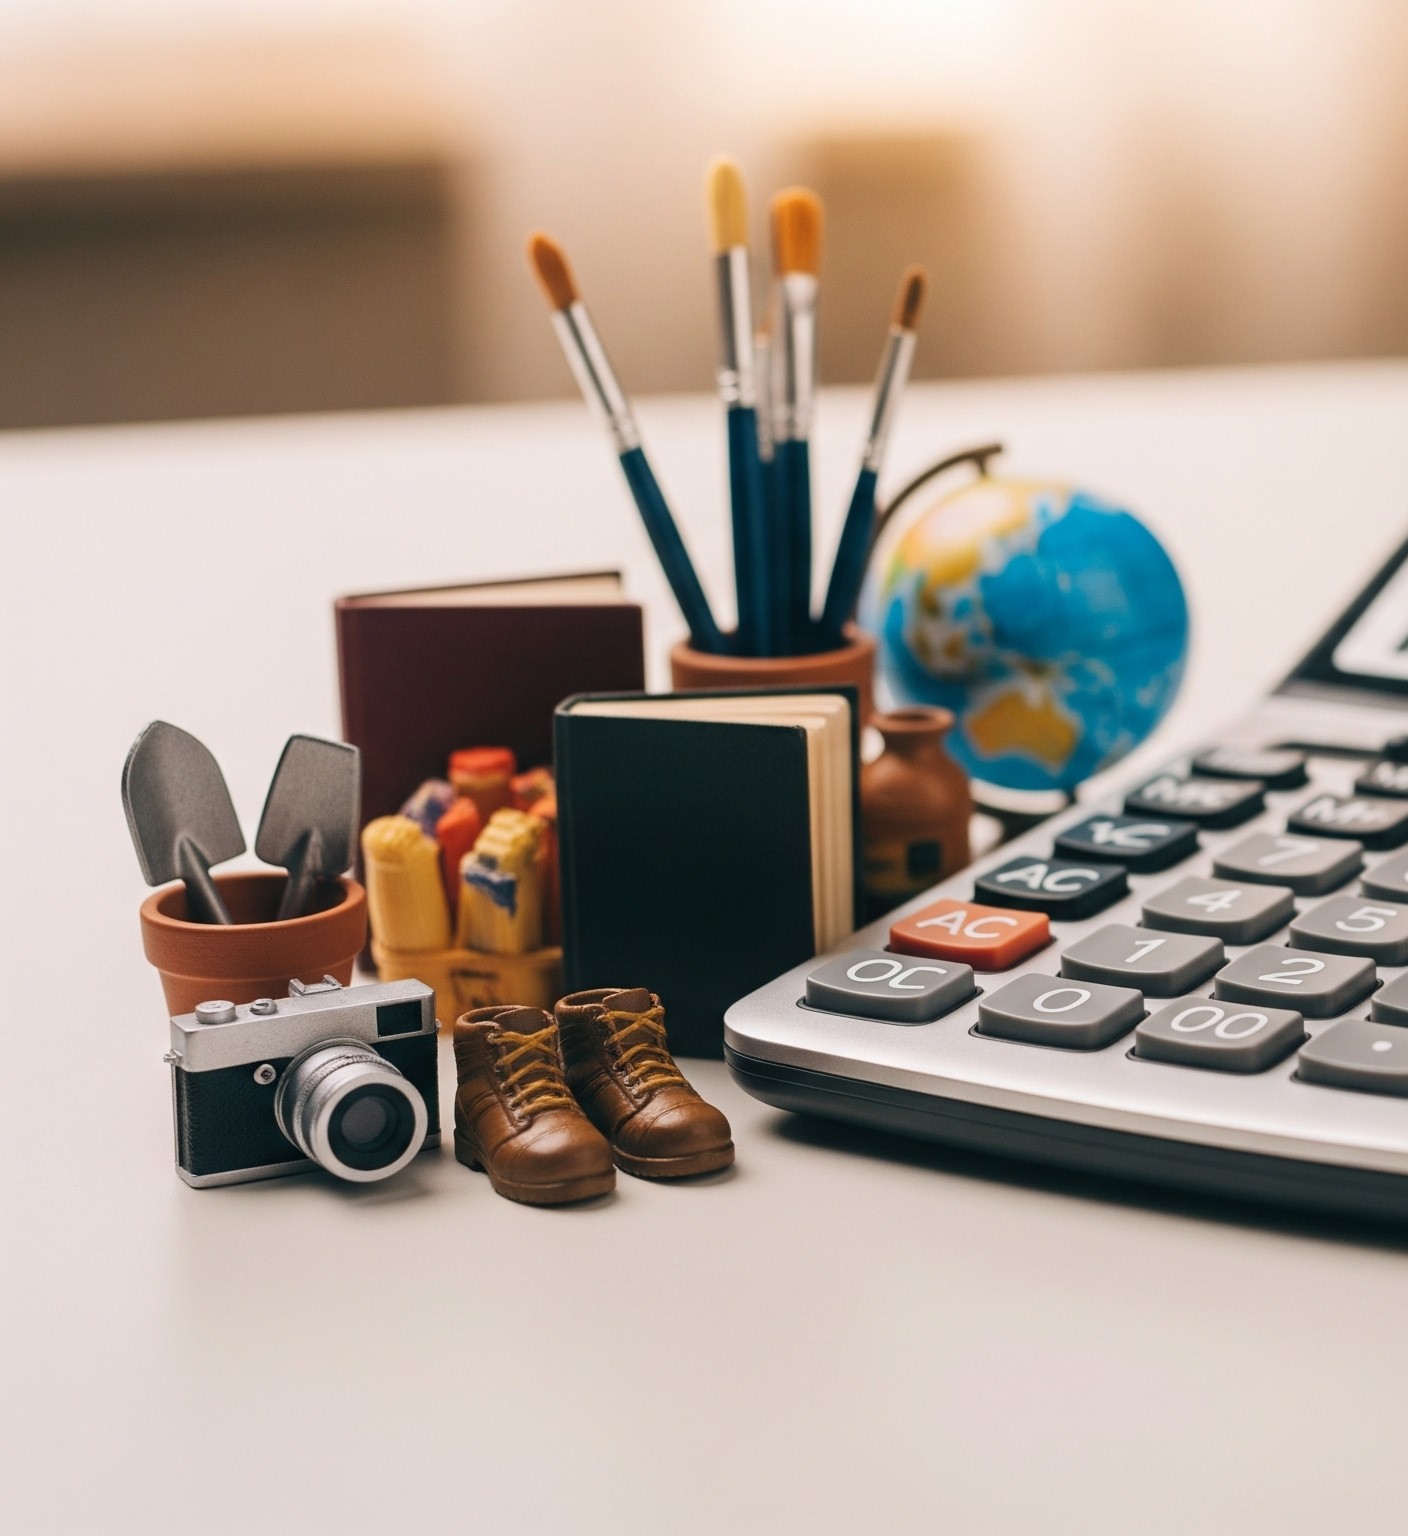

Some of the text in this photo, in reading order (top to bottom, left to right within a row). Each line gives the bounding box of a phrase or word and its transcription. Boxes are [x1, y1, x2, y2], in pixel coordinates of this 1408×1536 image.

[1257, 838, 1319, 866] 7
[995, 862, 1100, 893] AC
[1186, 888, 1242, 912] 4
[914, 909, 1018, 939] AC
[1335, 906, 1398, 933] 5
[1124, 938, 1167, 964] 1
[1257, 957, 1326, 985] 2
